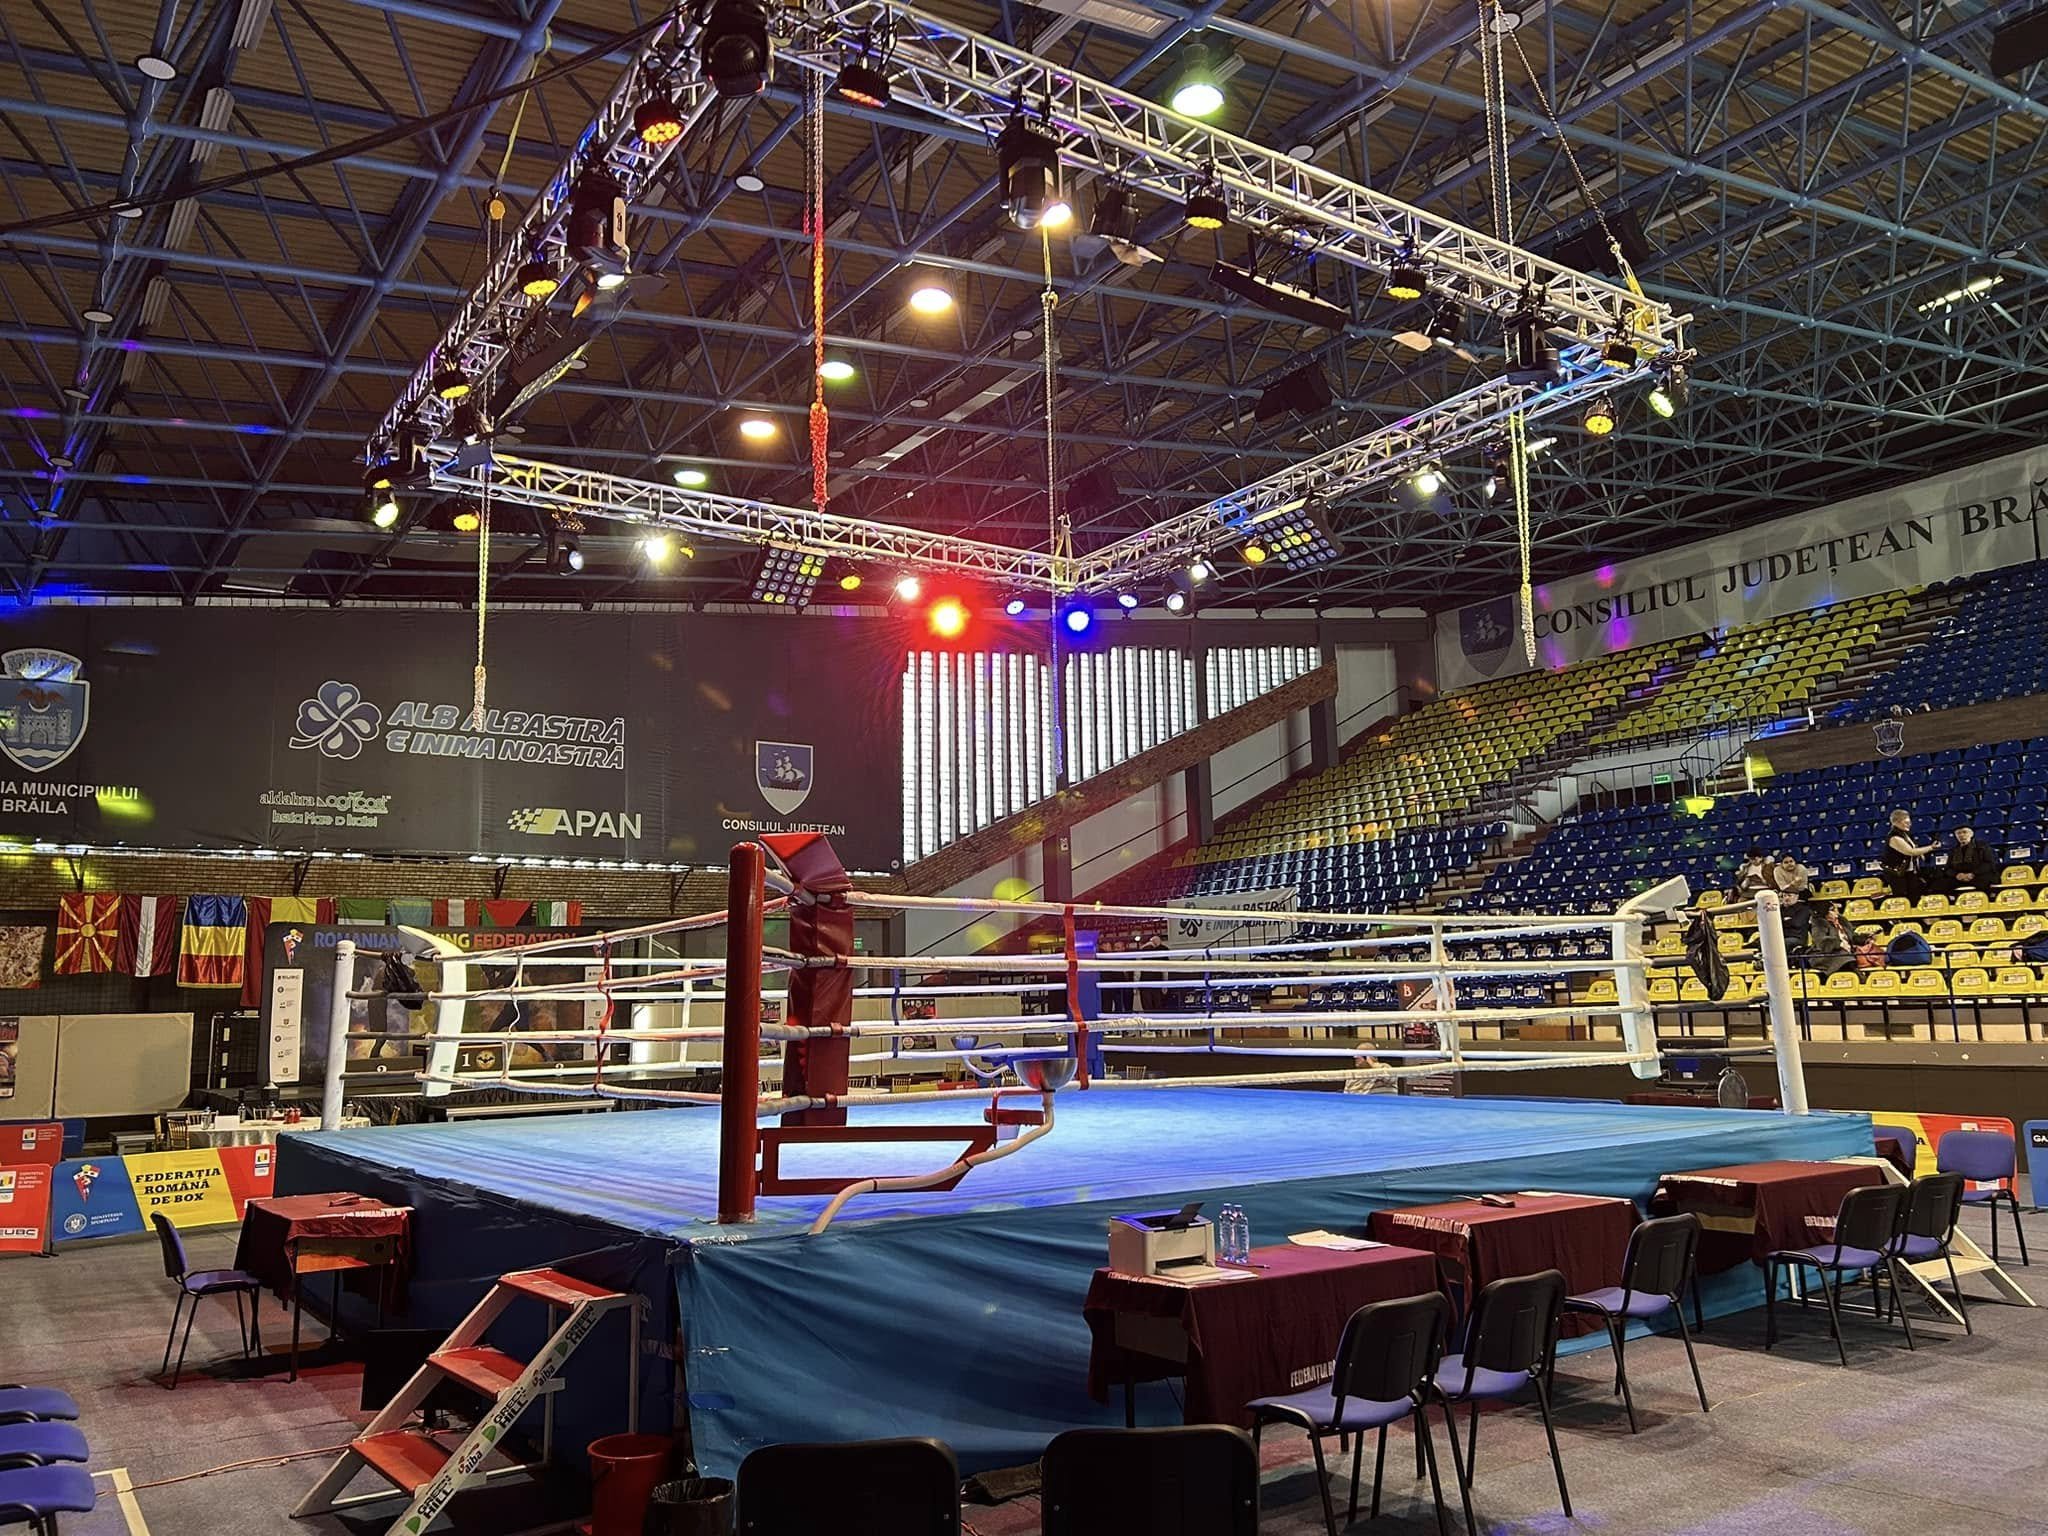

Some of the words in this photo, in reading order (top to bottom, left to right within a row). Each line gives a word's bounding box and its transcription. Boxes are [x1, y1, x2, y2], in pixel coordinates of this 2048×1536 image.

[1533, 576, 1706, 639] CONSILIUL
[1722, 515, 1935, 593] JUDEȚEAN
[387, 701, 460, 729] ALB
[410, 732, 496, 760] INIMA
[22, 782, 138, 800] MUNICIPIULUI
[2, 797, 68, 815] BRĂILA
[553, 809, 642, 839] APAN
[722, 818, 784, 833] CONSILIUL
[462, 1053, 471, 1067] 1
[135, 1167, 221, 1184] FEDERAȚIA
[151, 1195, 170, 1206] DE
[174, 1192, 204, 1203] BOX
[499, 1400, 529, 1428] HILL
[423, 1488, 454, 1519] HILL
